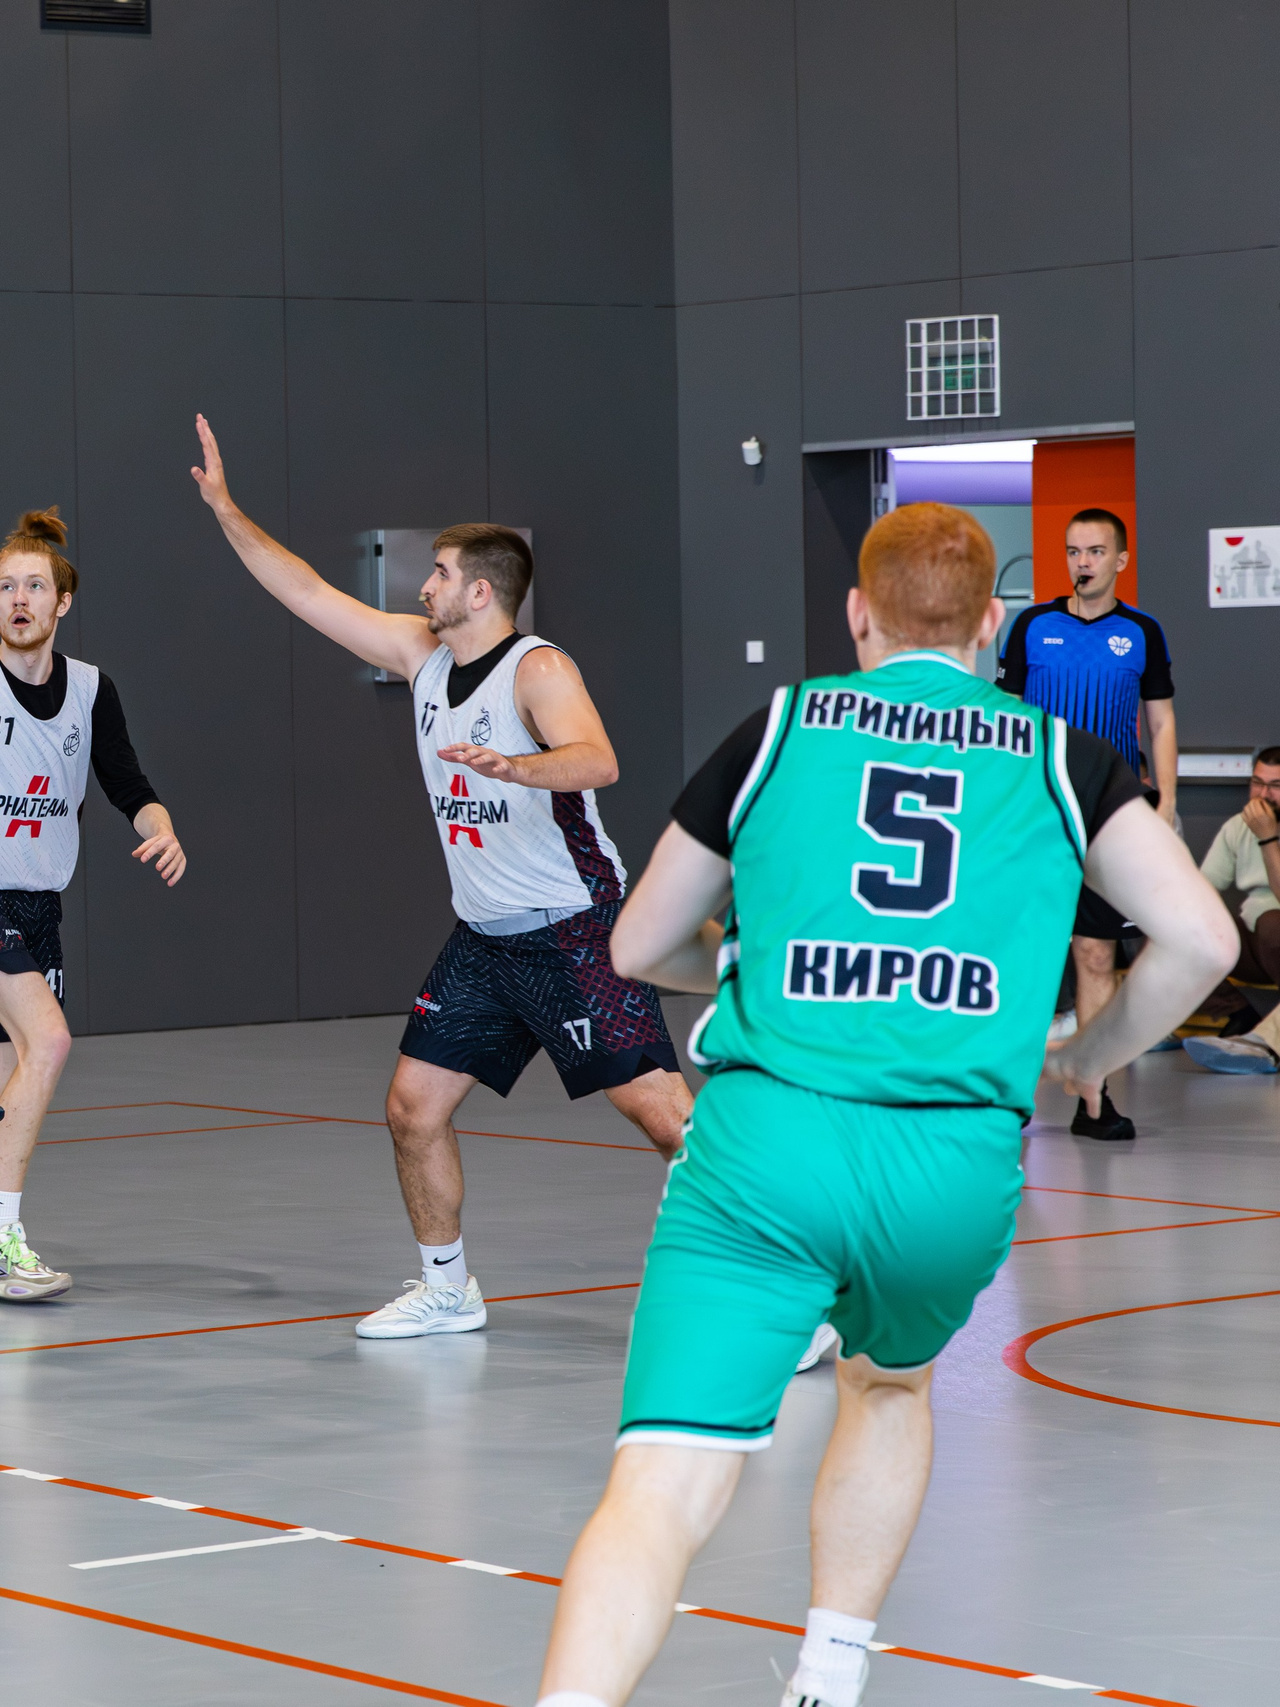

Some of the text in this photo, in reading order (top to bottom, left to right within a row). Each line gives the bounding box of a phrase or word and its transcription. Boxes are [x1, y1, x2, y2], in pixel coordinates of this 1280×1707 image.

[800, 688, 1035, 758] КРИНИЦЫН
[850, 760, 964, 919] 5
[783, 939, 999, 1016] КИРОВ
[562, 1017, 592, 1050] 17
